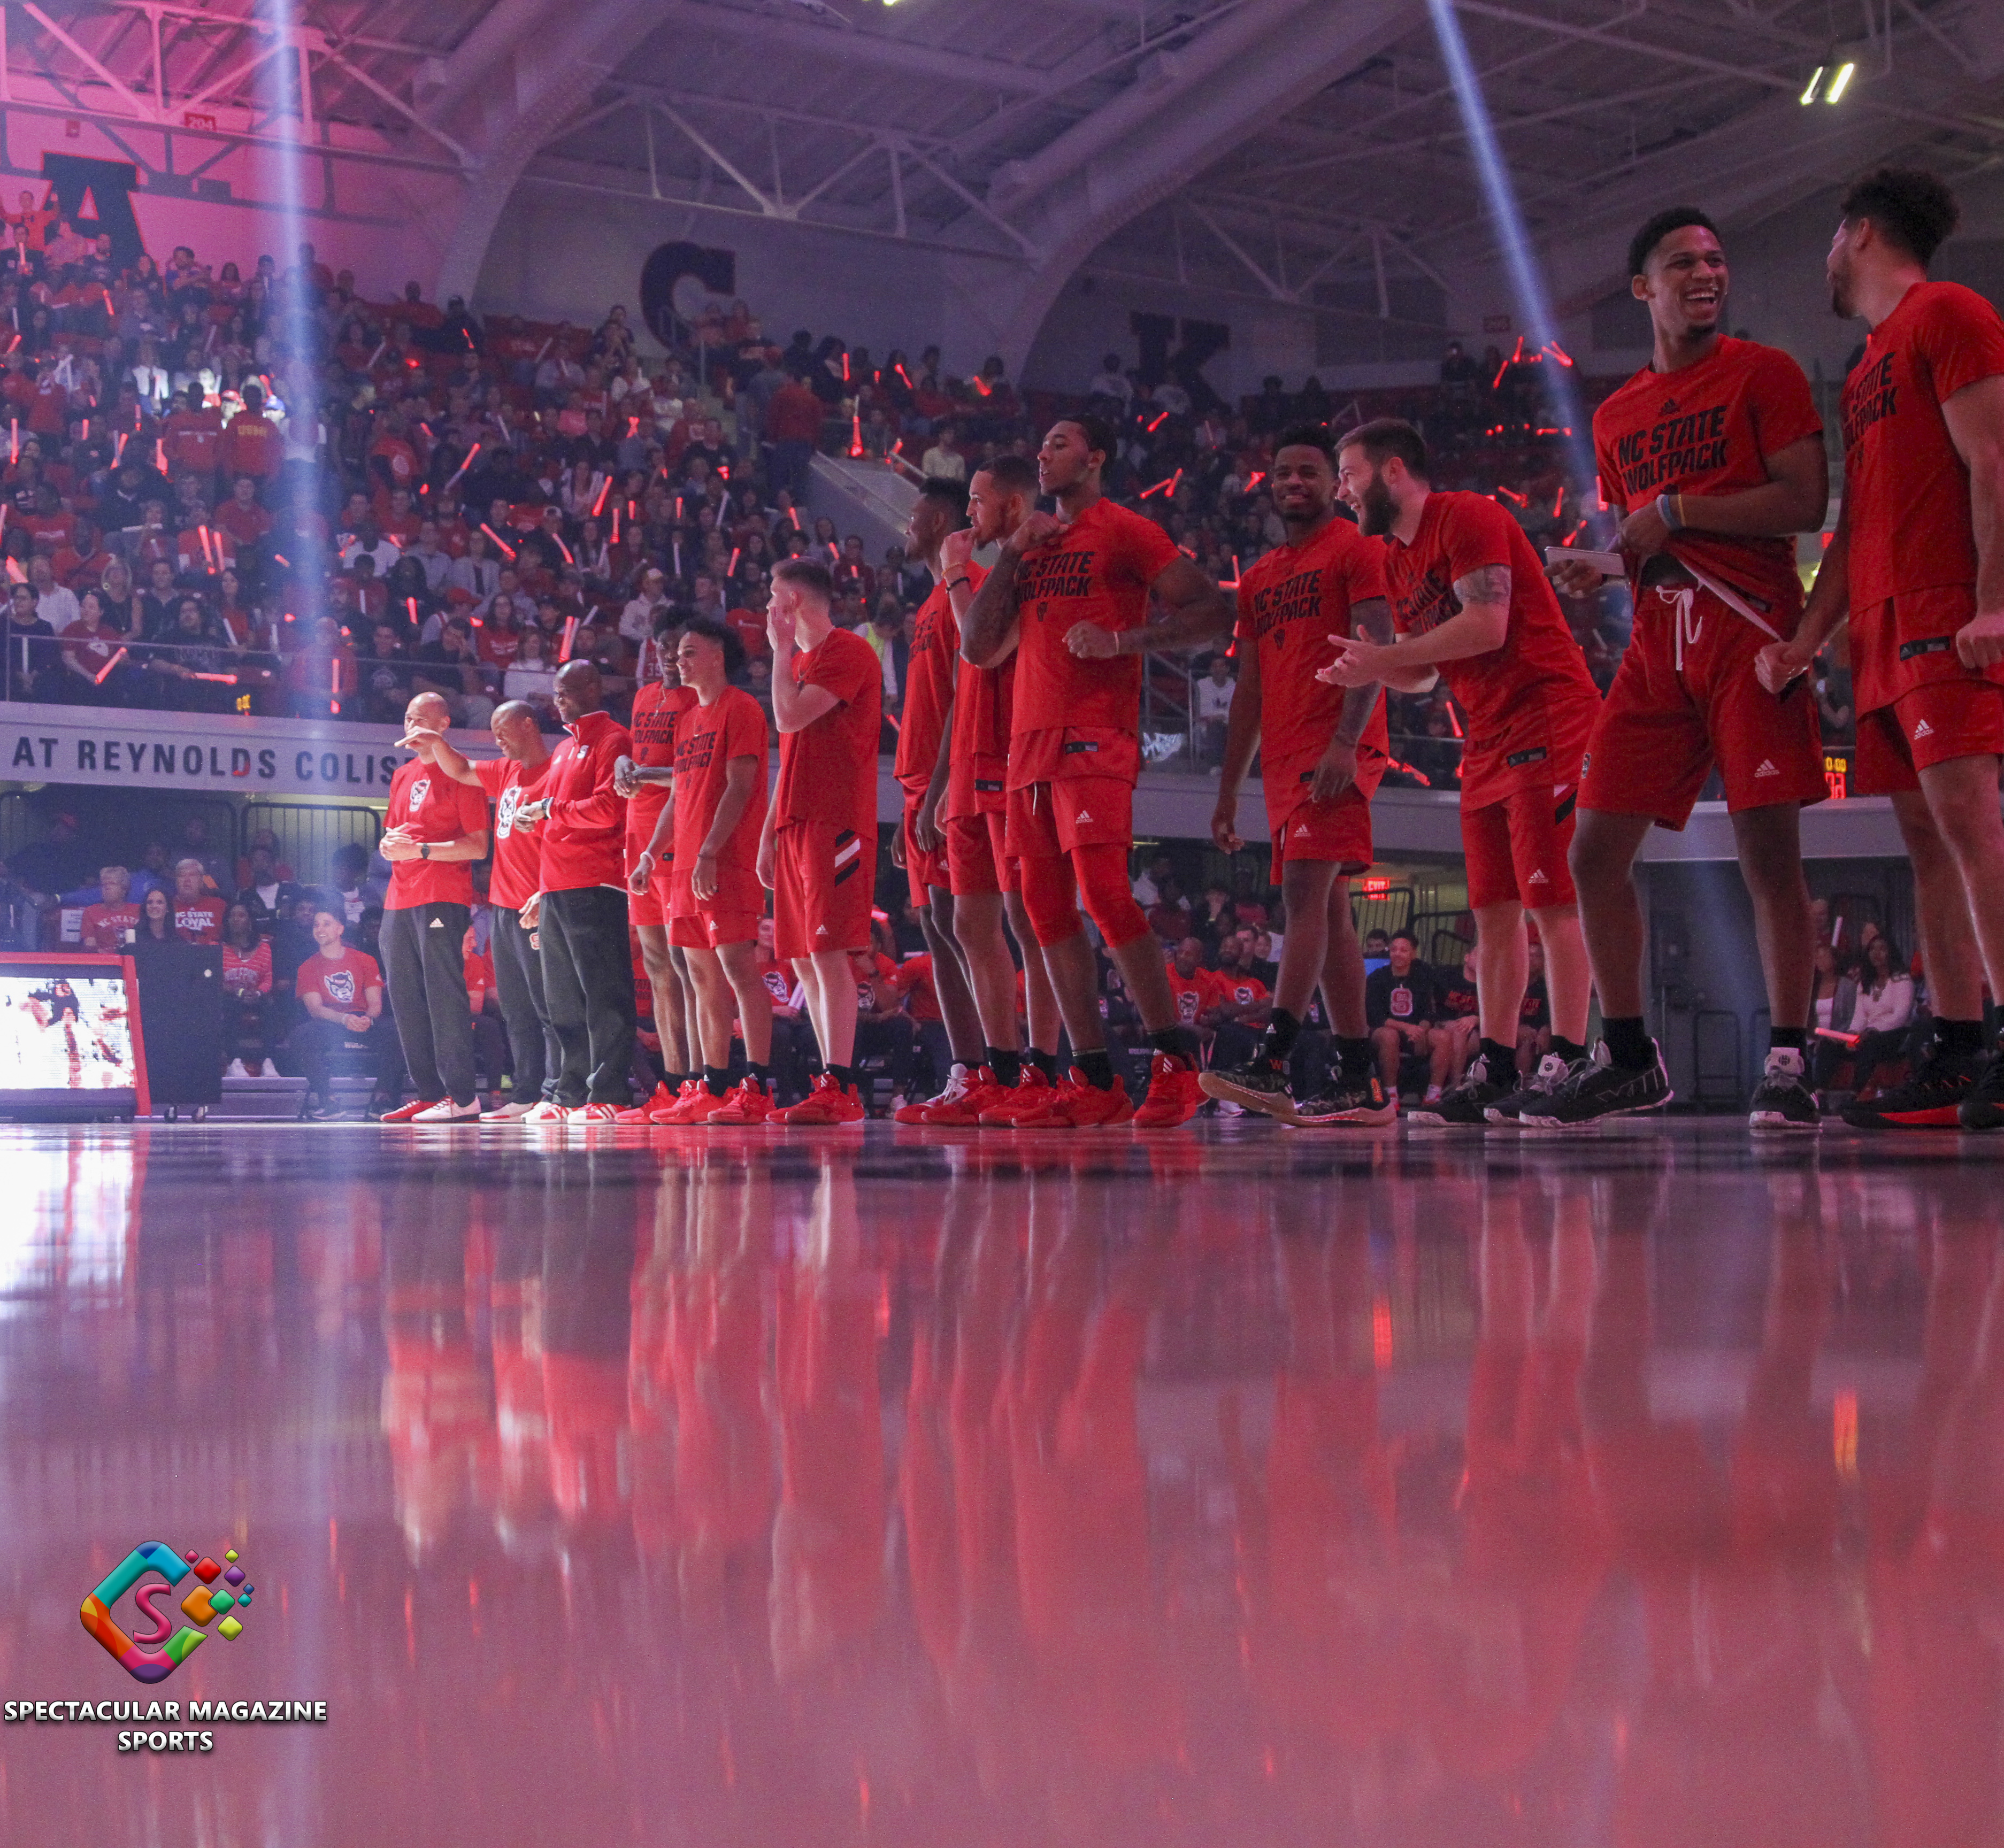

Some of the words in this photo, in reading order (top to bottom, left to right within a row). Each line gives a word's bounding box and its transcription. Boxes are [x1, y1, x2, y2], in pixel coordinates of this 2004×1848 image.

[1619, 430, 1647, 469] NC
[1650, 405, 1727, 455] STATE
[1623, 438, 1729, 496] WOLFPACK
[1036, 551, 1096, 577] STATE
[1272, 569, 1323, 606] STATE
[12, 736, 58, 767] AT
[78, 739, 275, 779] REYNOLDS
[1754, 769, 1780, 778] adidas
[175, 918, 216, 930] LOYAL
